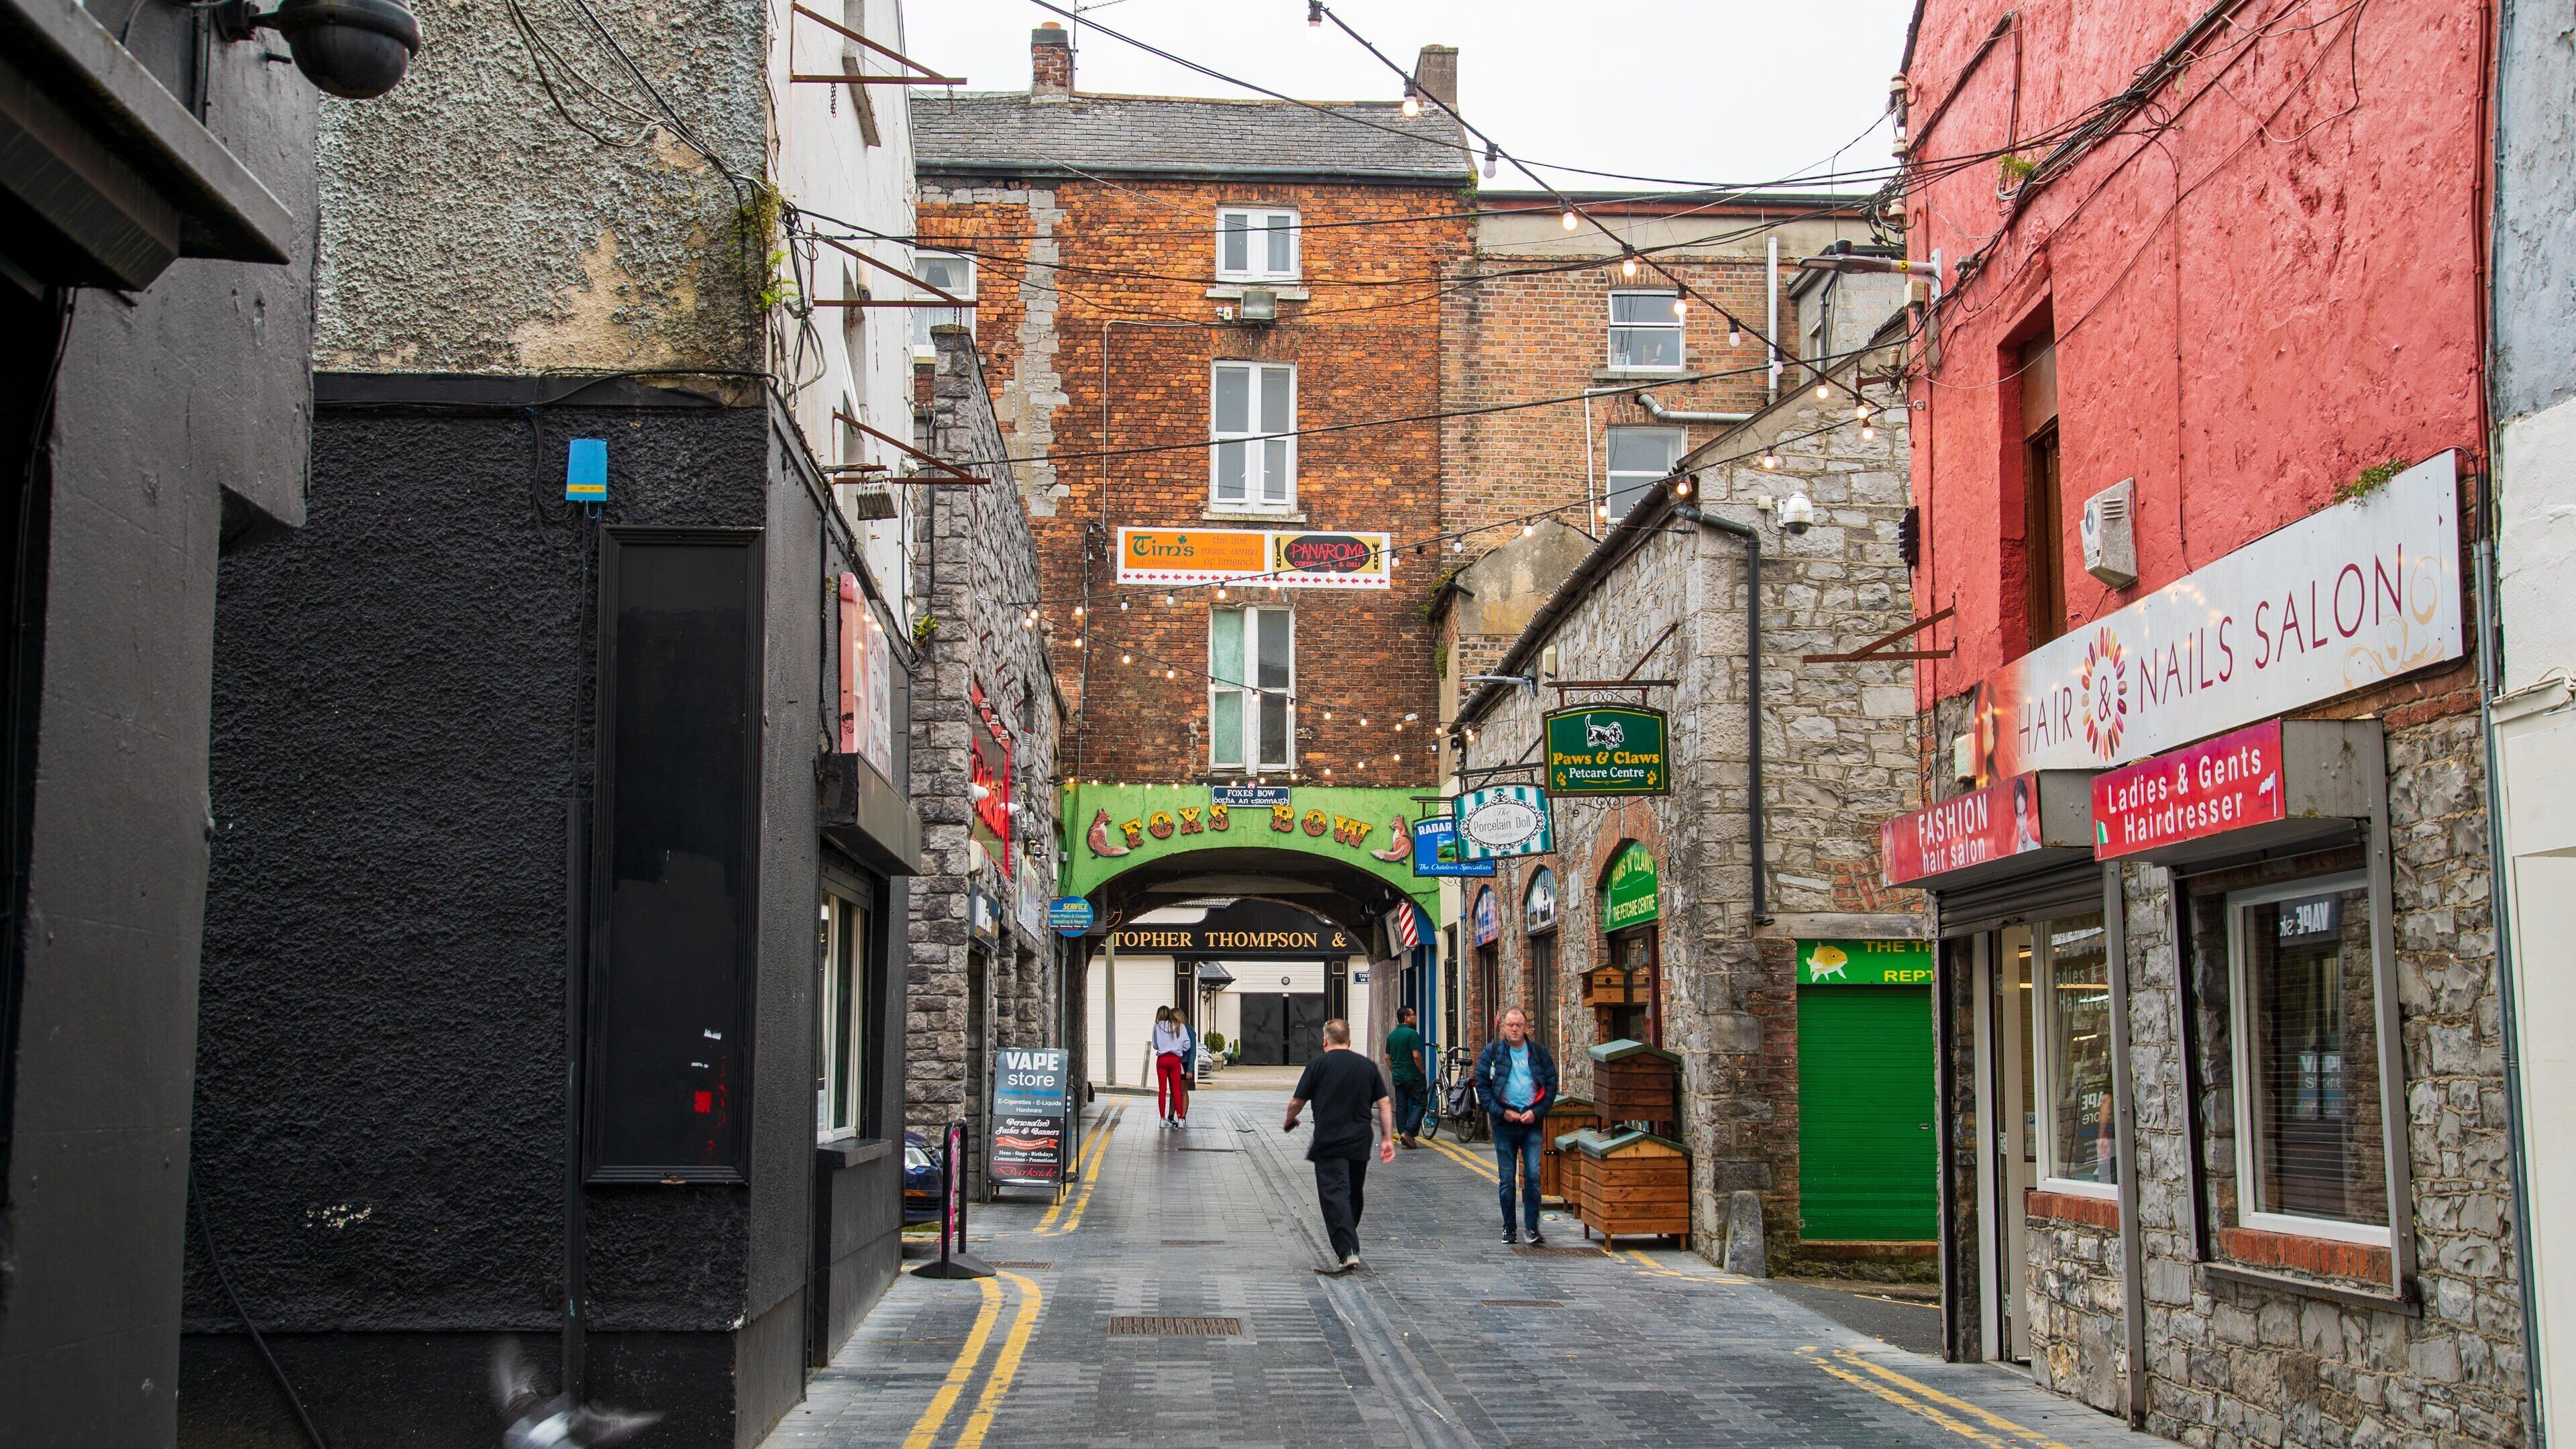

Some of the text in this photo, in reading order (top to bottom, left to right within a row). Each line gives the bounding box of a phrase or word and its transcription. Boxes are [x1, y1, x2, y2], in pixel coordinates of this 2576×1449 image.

[1132, 535, 1194, 556] Tim's
[1213, 535, 1247, 545] the live
[1201, 547, 1258, 556] music venue
[1290, 543, 1365, 561] PANAROMA
[2018, 542, 2402, 759] HAIR & NAILS SALON
[1552, 751, 1660, 765] Paws & Claws
[1568, 767, 1644, 779] Petcare Centre
[2108, 745, 2262, 814] Ladies & Gents
[1227, 789, 1253, 797] FOXES
[1493, 807, 1510, 816] The
[2124, 792, 2243, 845] Hairdresser
[1120, 804, 1373, 849] FOXS BOW
[1417, 822, 1452, 836] RADAR
[1473, 814, 1531, 833] Porcelain Doll
[1917, 793, 1988, 849] FASHION
[1634, 851, 1654, 875] CLAWS
[1922, 835, 1986, 875] hair salon
[1620, 899, 1638, 920] PETCARE
[1638, 893, 1656, 914] CENTRE
[1100, 932, 1347, 947] TOPHER THOMPSON &
[1863, 941, 1906, 953] THE
[1006, 1051, 1059, 1071] VAPE
[1008, 1071, 1055, 1087] store
[995, 1126, 1060, 1136] Sashes & Banners
[1006, 1118, 1050, 1127] Personalised
